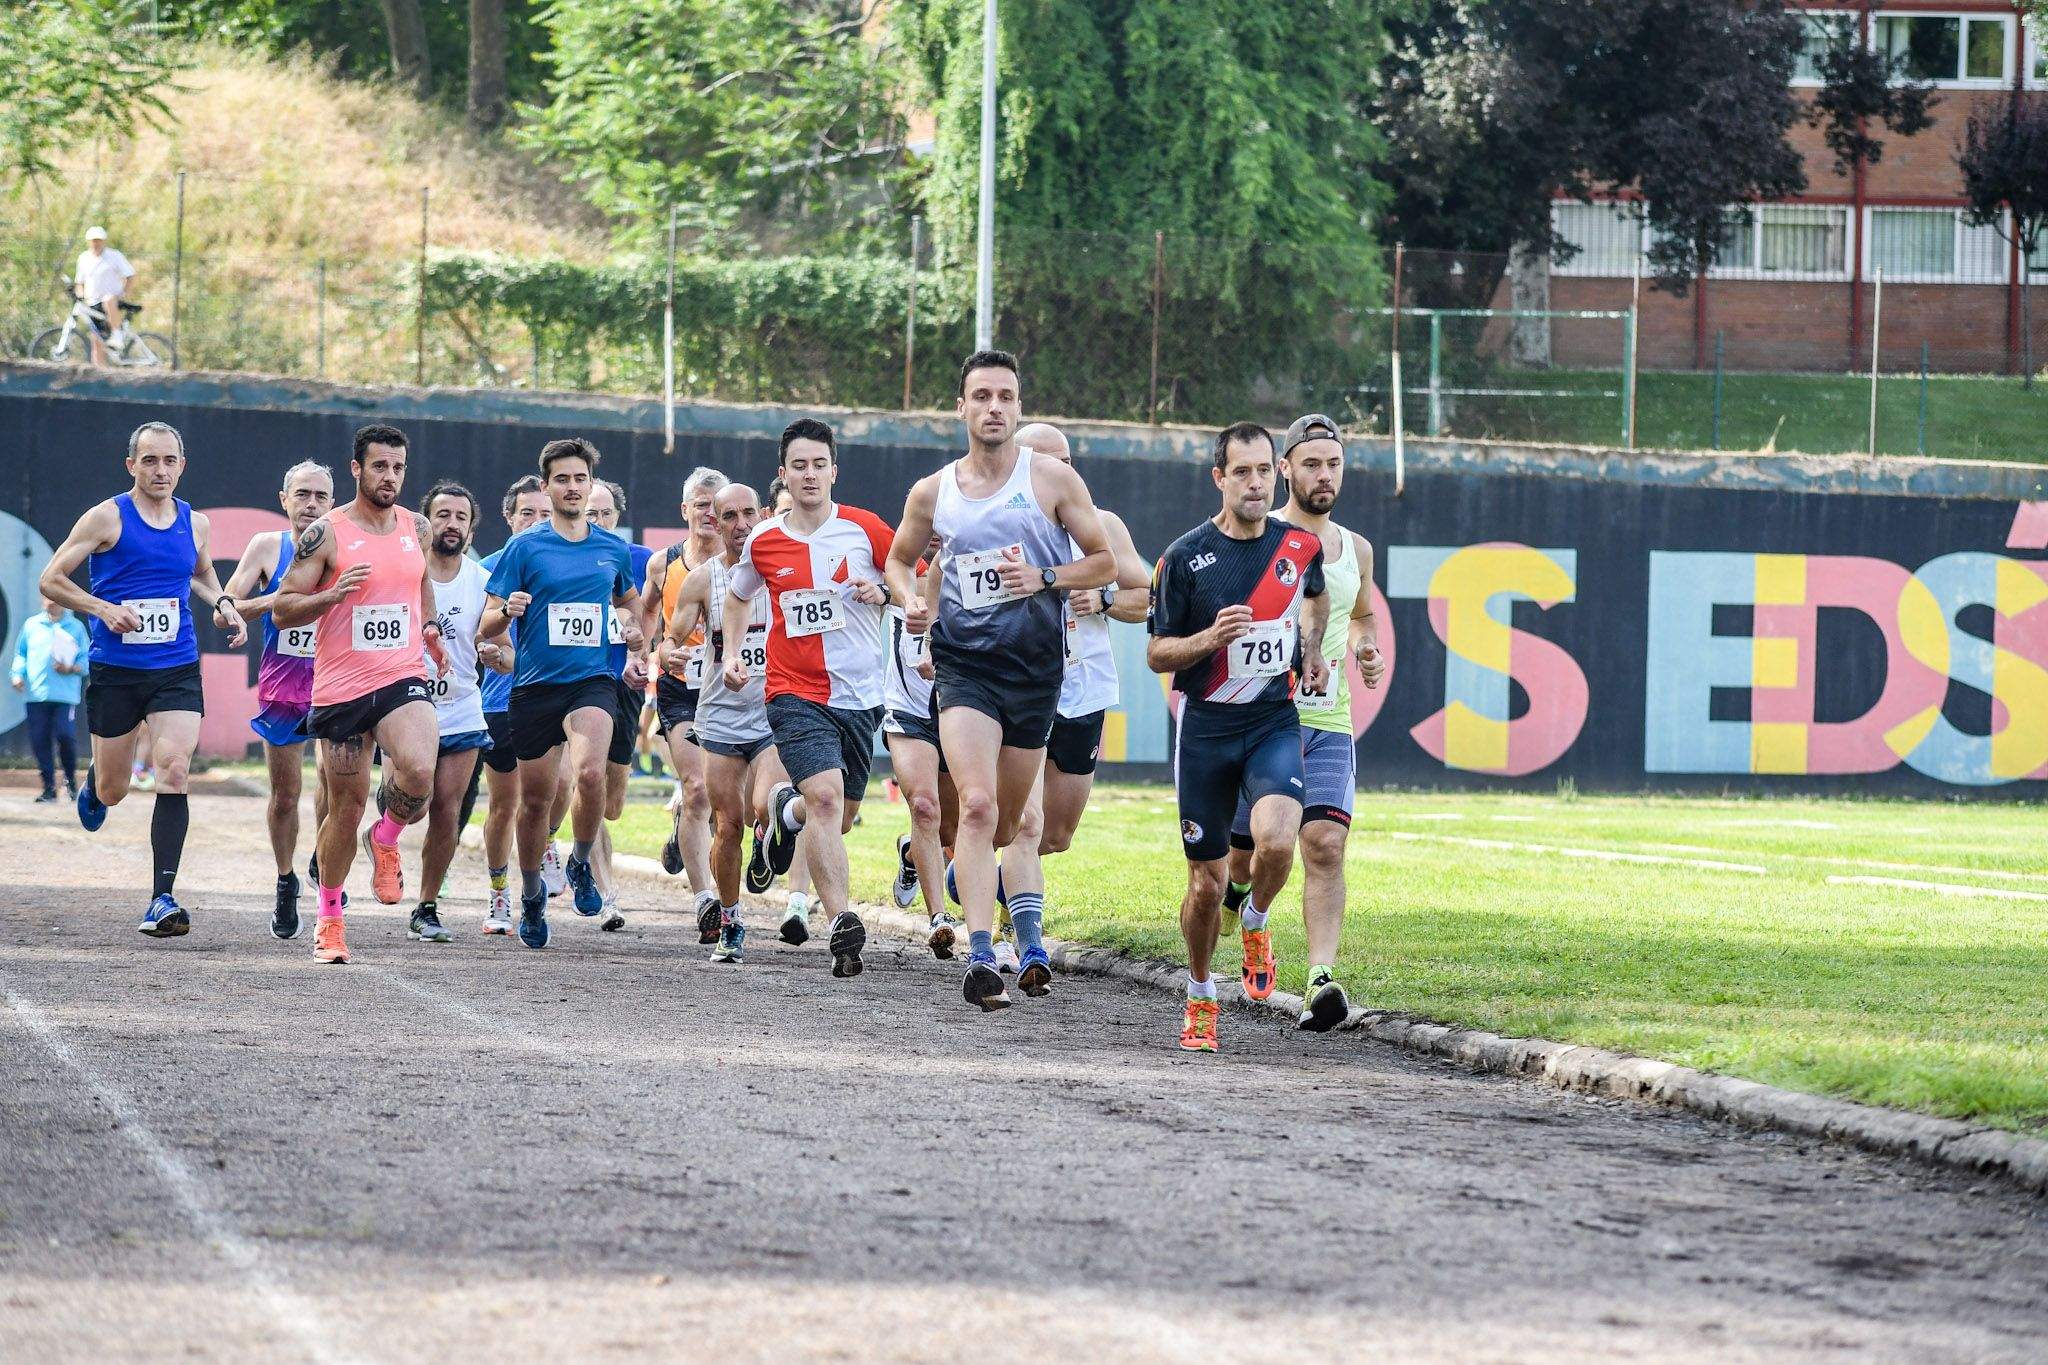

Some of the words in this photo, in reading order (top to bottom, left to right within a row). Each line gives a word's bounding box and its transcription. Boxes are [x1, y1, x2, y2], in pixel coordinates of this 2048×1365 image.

[1004, 502, 1031, 510] adidas
[1188, 552, 1217, 573] CAG
[792, 600, 833, 625] 785
[363, 619, 401, 641] 698
[559, 618, 593, 637] 790
[288, 630, 317, 648] 87
[1241, 638, 1283, 665] 781
